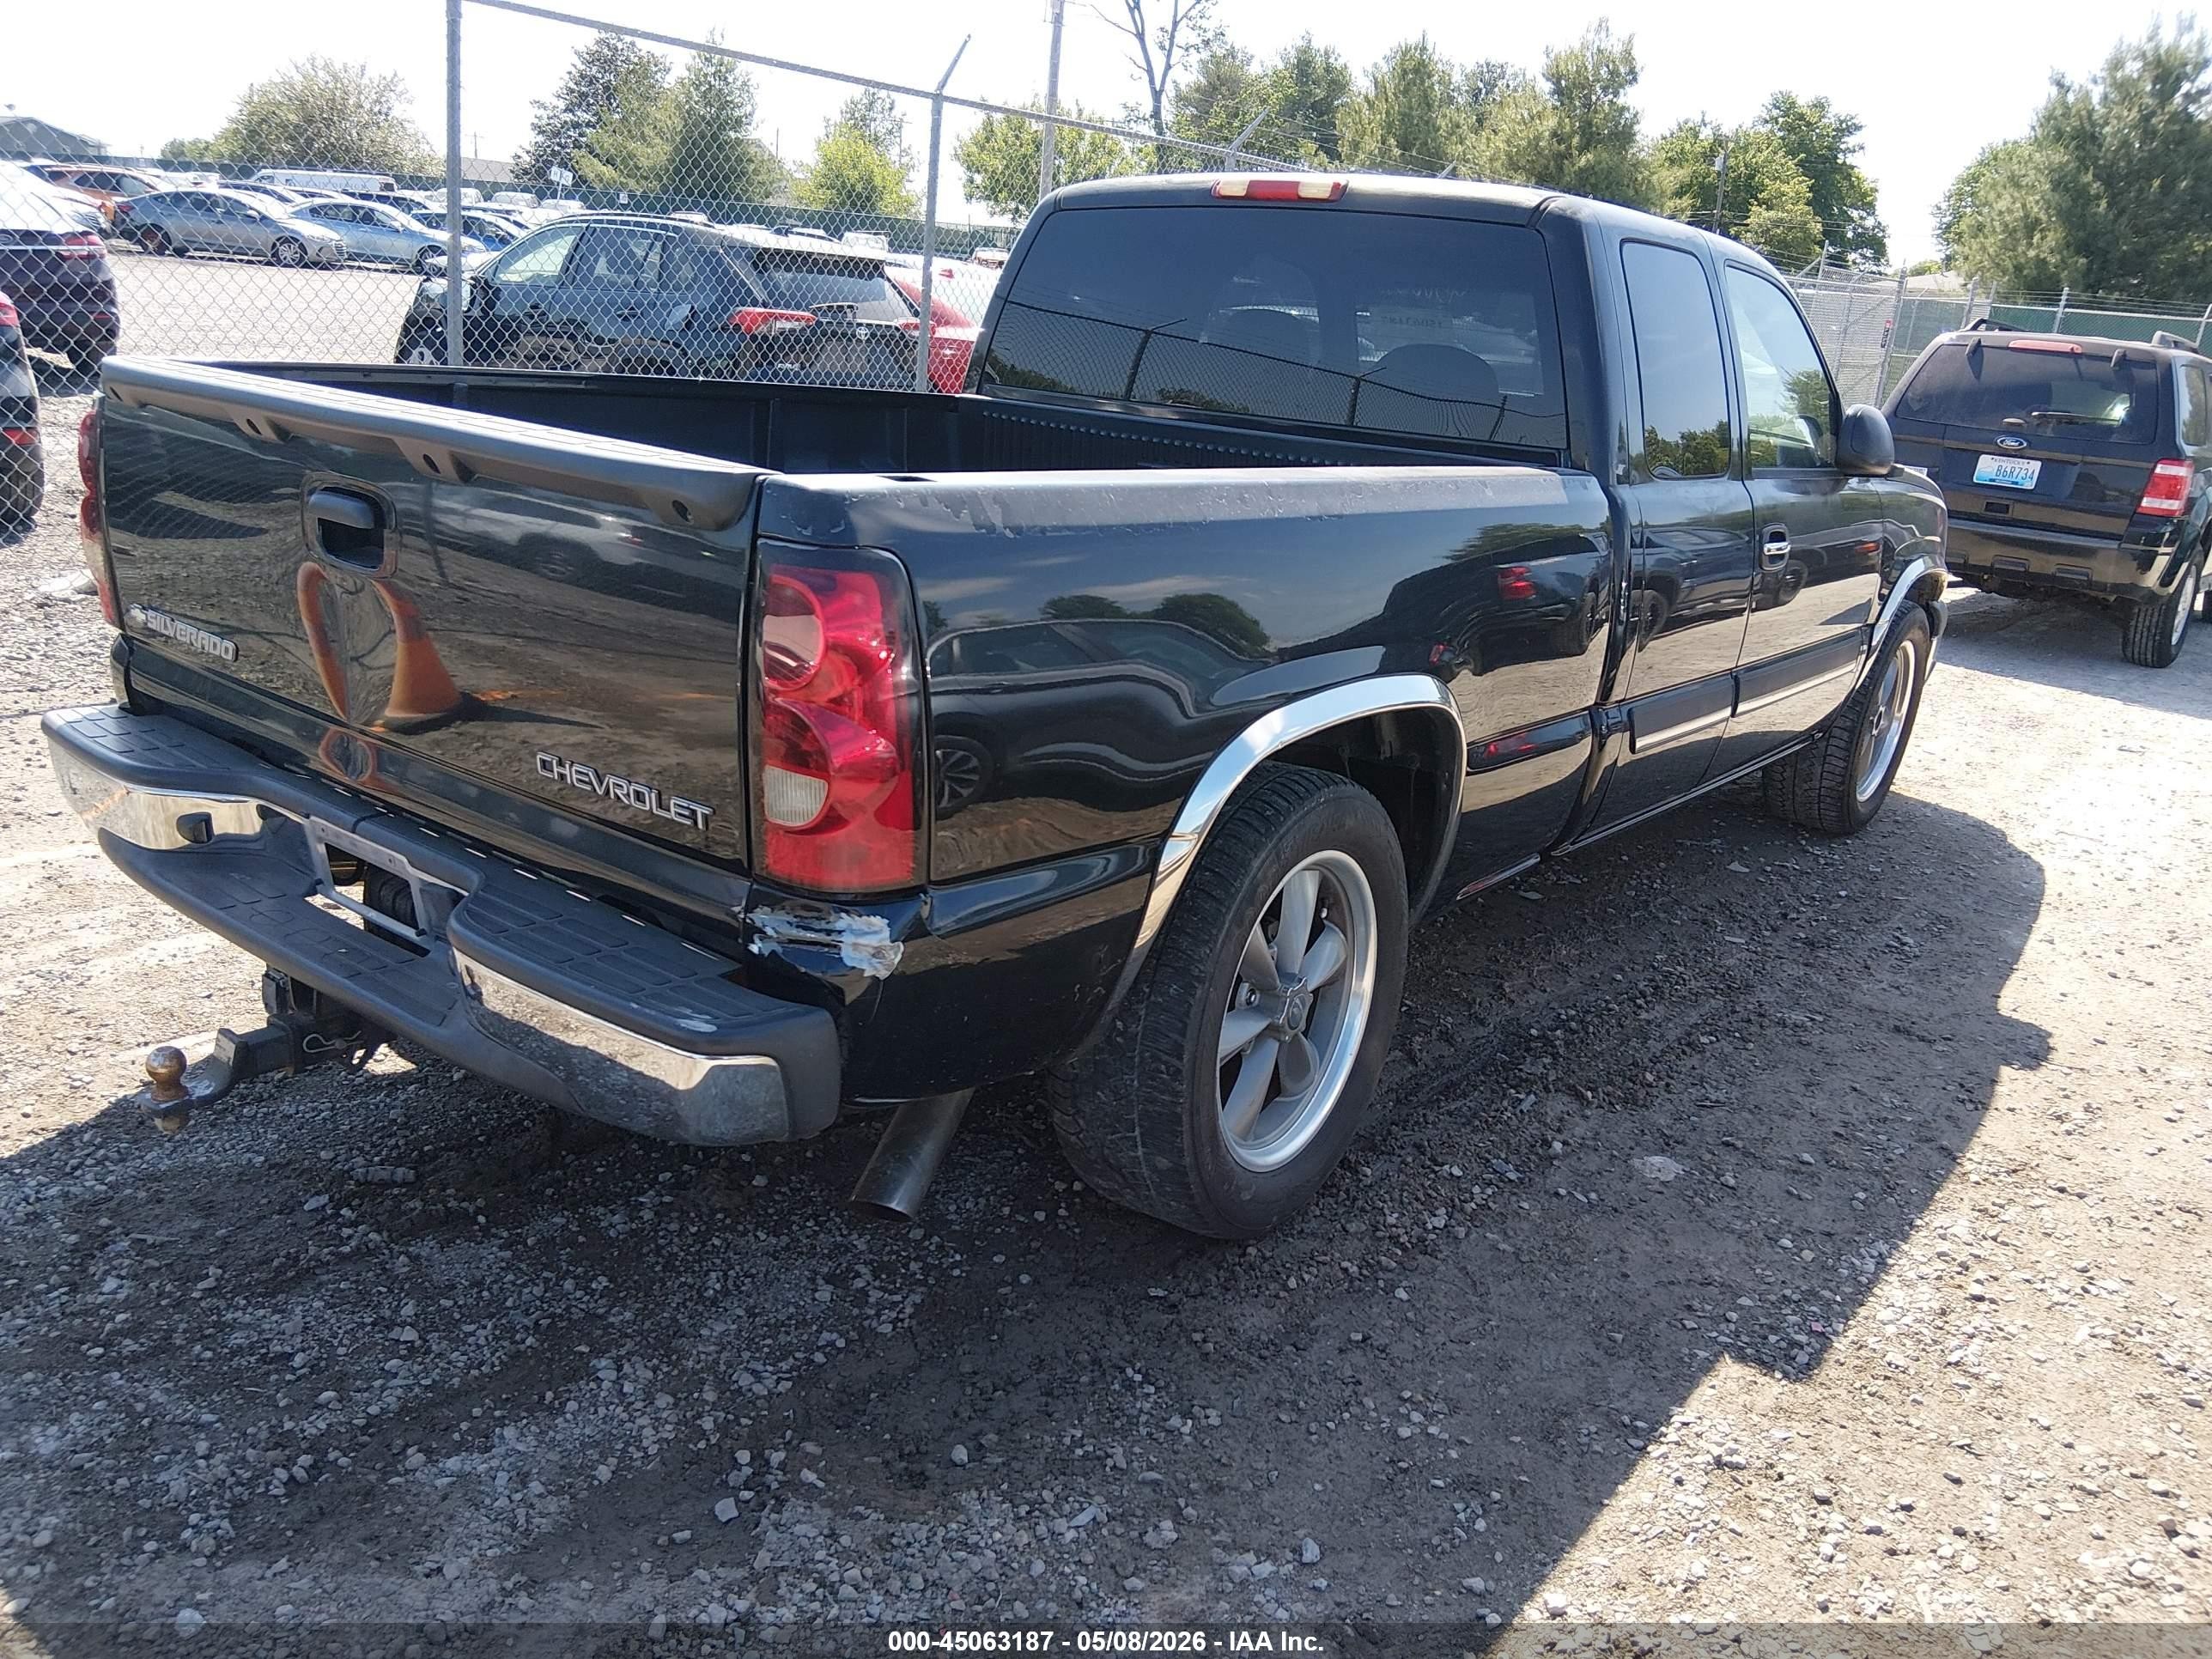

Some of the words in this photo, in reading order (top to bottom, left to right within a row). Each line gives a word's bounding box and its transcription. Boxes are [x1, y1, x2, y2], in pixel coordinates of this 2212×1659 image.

[1996, 465, 2035, 481] B6R734
[146, 609, 237, 661] SILVERADO
[536, 751, 714, 831] CHEVROLET
